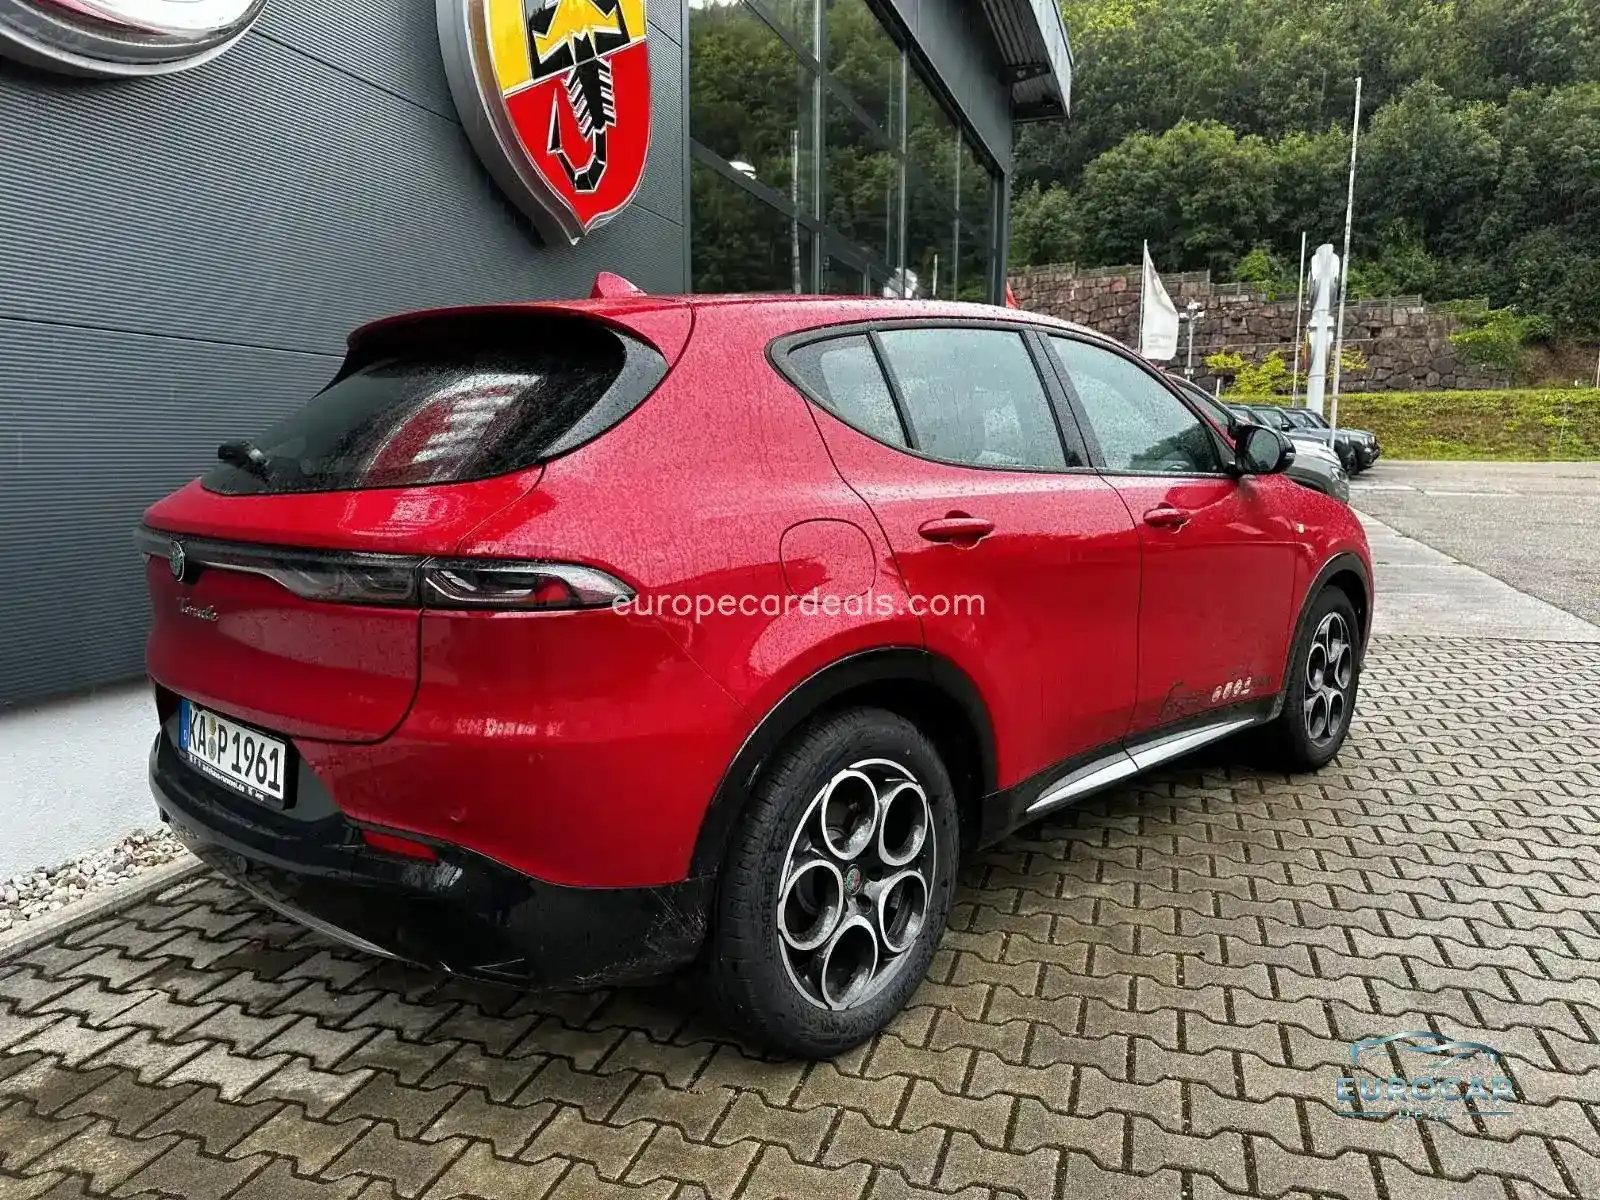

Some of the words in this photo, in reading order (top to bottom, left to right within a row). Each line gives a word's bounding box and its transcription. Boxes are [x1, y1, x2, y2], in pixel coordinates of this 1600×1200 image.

[189, 709, 206, 756] KA
[217, 724, 228, 764] P
[232, 731, 281, 793] 1961
